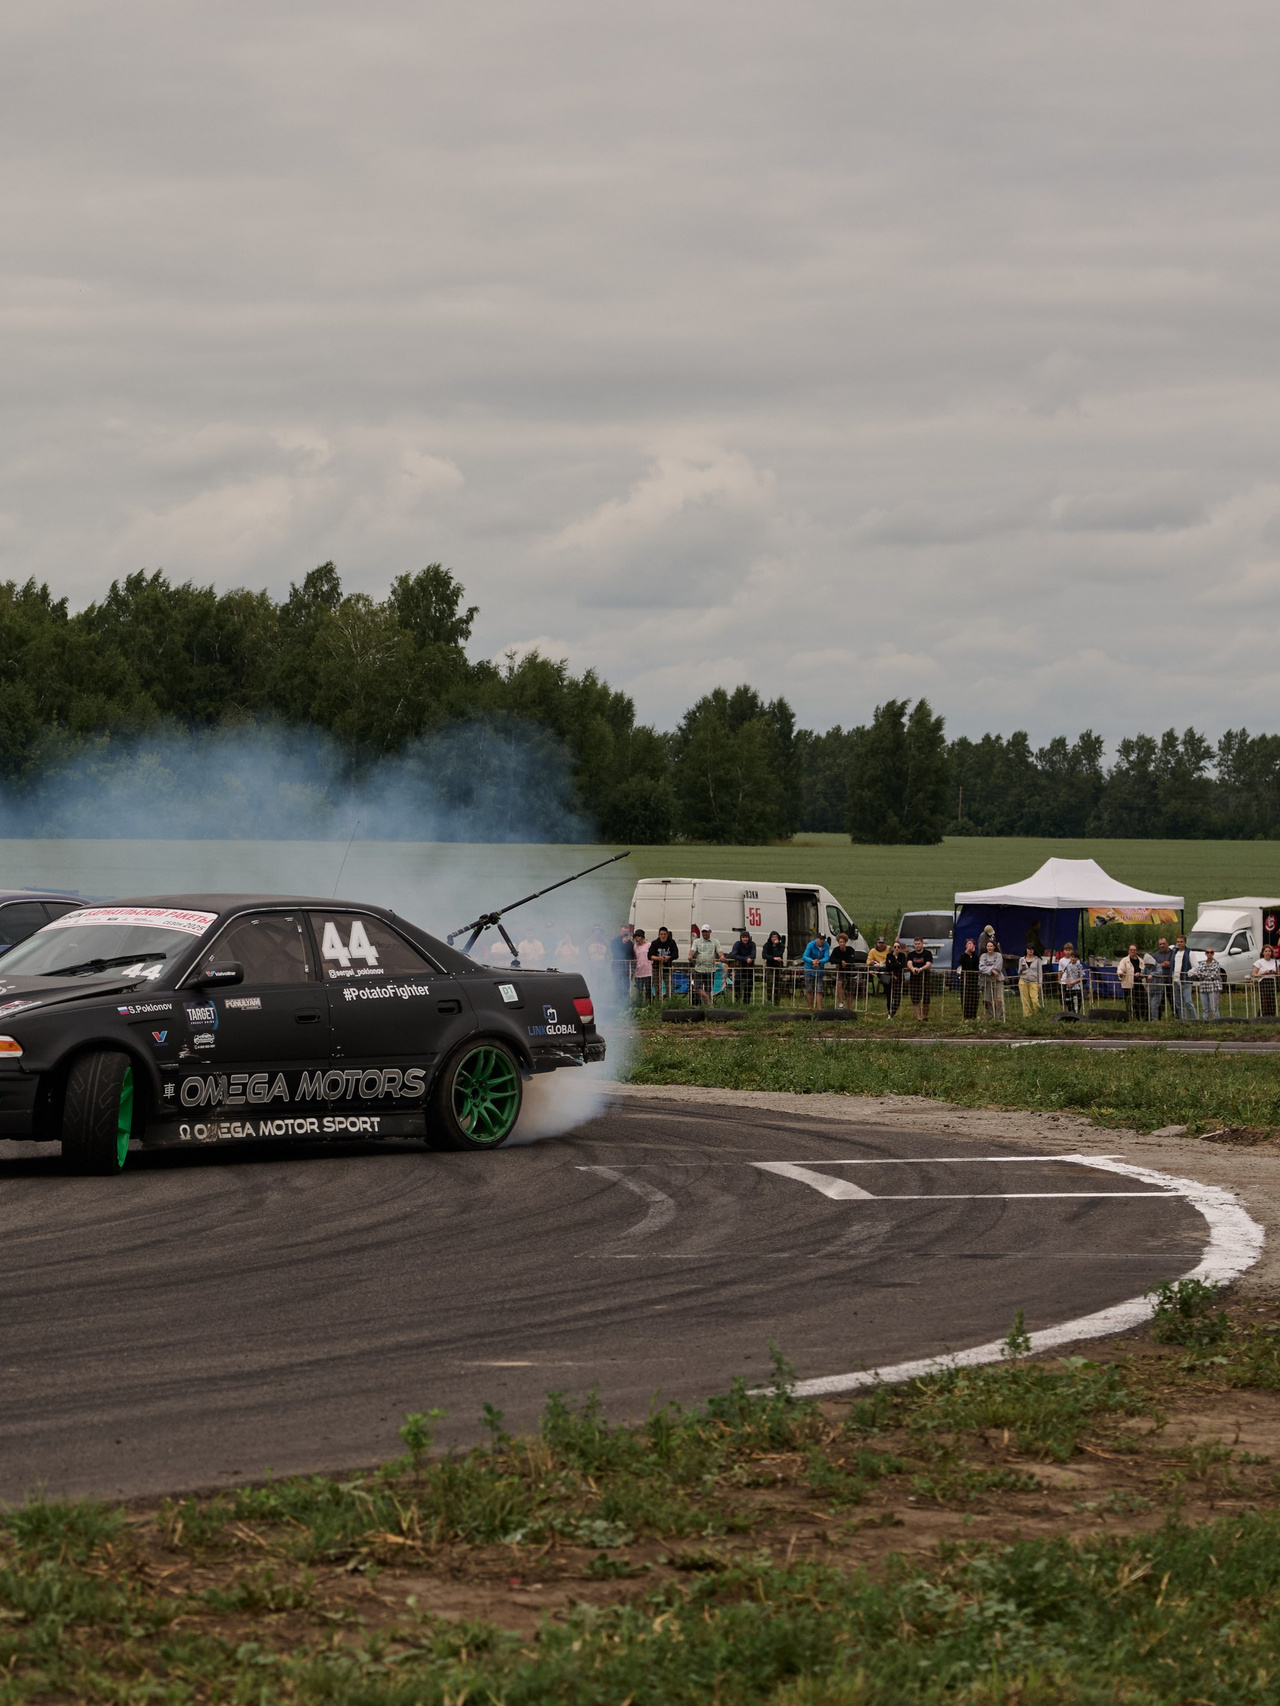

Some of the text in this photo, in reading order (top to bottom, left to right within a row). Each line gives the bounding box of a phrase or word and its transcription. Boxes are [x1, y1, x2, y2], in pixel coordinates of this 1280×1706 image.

[165, 910, 216, 925] РАКЕТЫ
[182, 922, 207, 931] 2025
[321, 920, 380, 968] 44
[121, 962, 164, 981] 44
[342, 984, 430, 1002] #PotatoFighter
[128, 1002, 173, 1015] S.Poklonov
[186, 1007, 215, 1021] TARGET
[163, 1083, 176, 1099] 車
[180, 1067, 427, 1107] OMEGA MOTORS
[259, 1118, 320, 1137] MOTOR
[323, 1116, 381, 1133] SPORT
